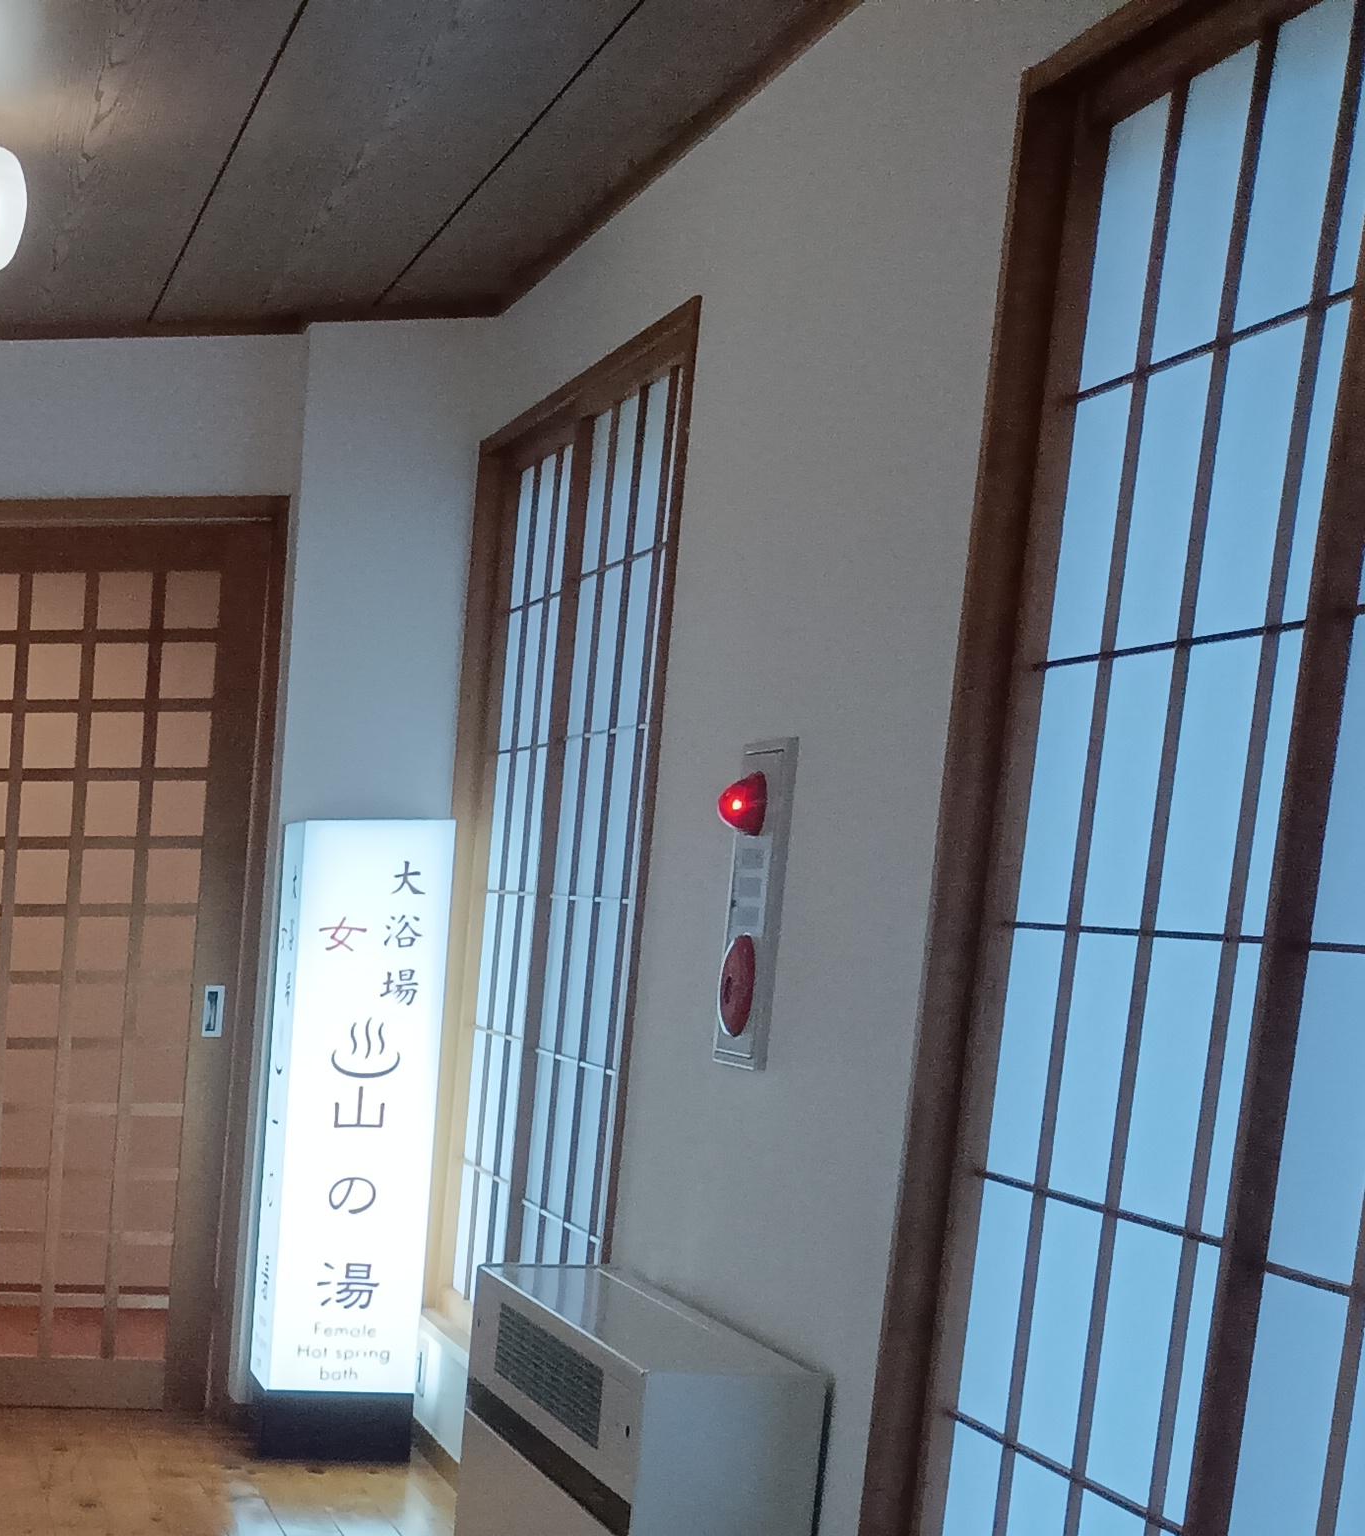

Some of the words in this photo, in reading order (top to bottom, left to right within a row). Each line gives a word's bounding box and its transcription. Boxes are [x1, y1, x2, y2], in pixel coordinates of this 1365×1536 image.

[318, 916, 368, 952] 女
[380, 860, 426, 1006] 大浴場
[316, 1085, 386, 1310] 山の湯
[313, 1321, 377, 1338] Female
[297, 1344, 328, 1360] Hot
[335, 1347, 391, 1366] spring
[318, 1365, 359, 1382] bath
